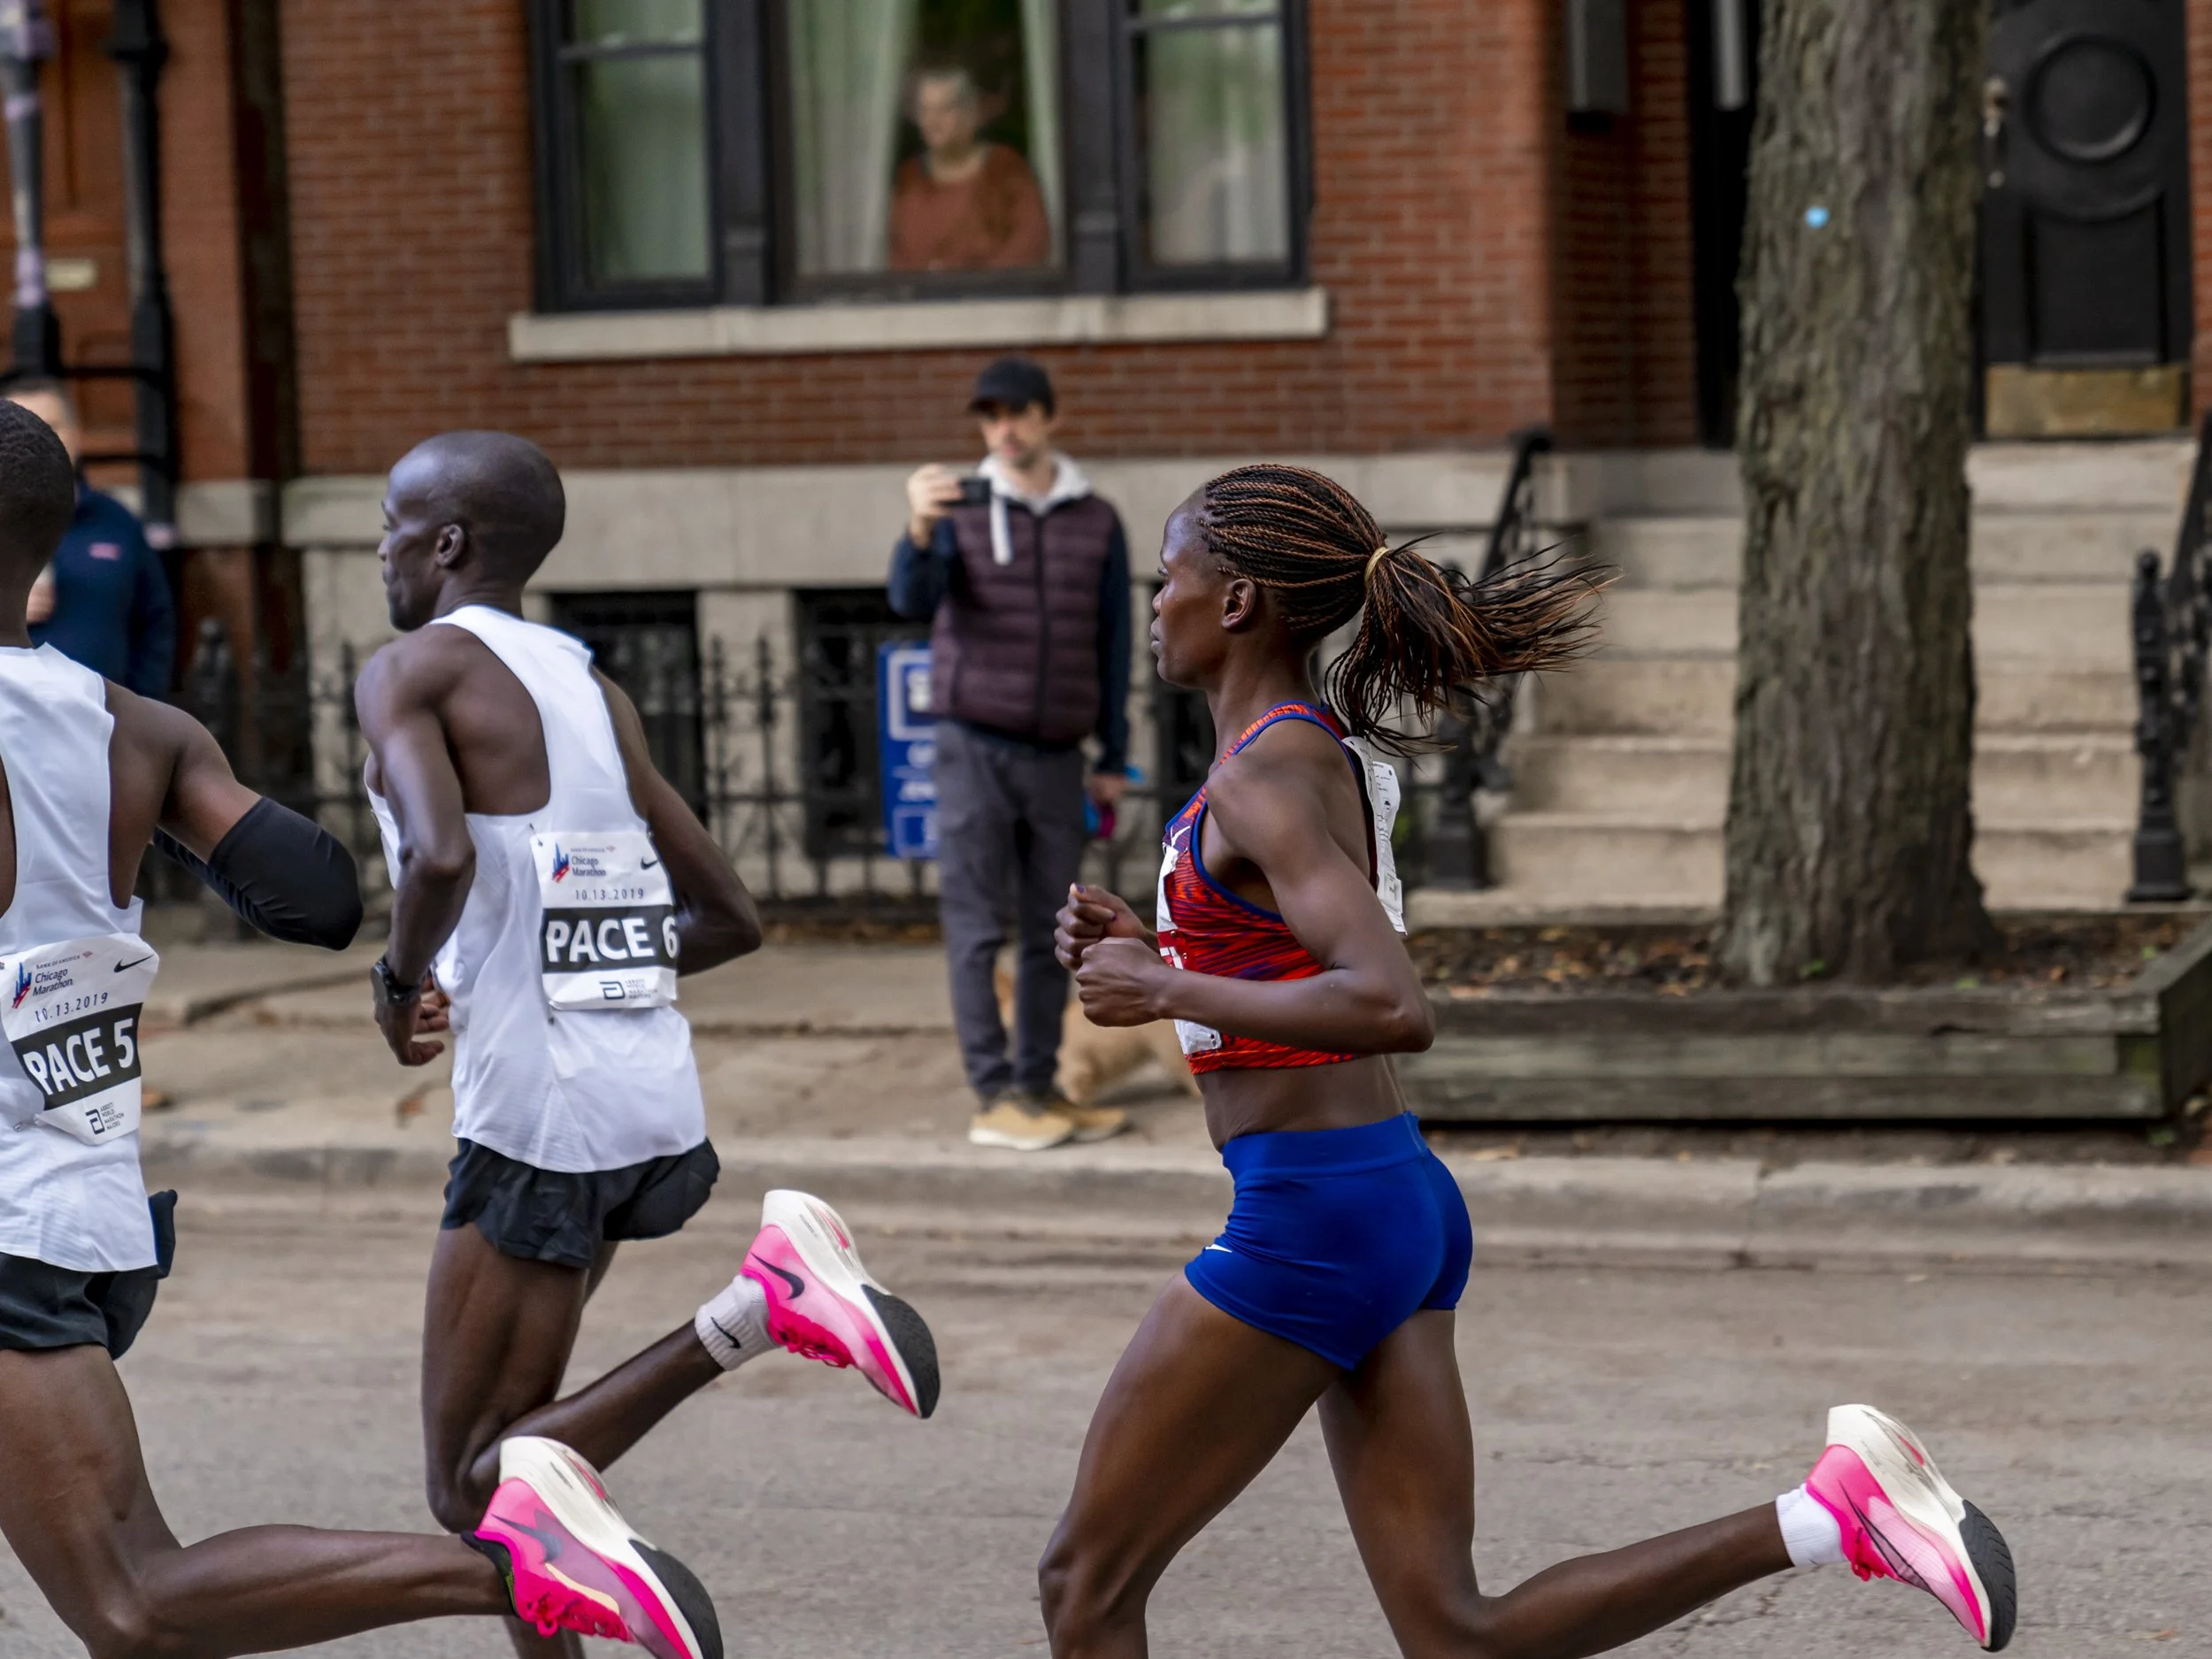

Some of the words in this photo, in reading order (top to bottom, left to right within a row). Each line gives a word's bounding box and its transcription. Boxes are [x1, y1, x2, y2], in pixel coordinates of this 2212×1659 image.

[571, 856, 599, 867] Chicago
[572, 867, 607, 877] Marathon
[575, 887, 644, 901] 10.13.2019
[545, 918, 654, 963] PACE
[662, 916, 679, 959] 6
[35, 968, 68, 984] Chicago
[33, 978, 73, 997] Marathon
[35, 992, 108, 1023] 10.13.2019
[23, 1027, 111, 1096] PACE
[113, 1018, 134, 1069] 5
